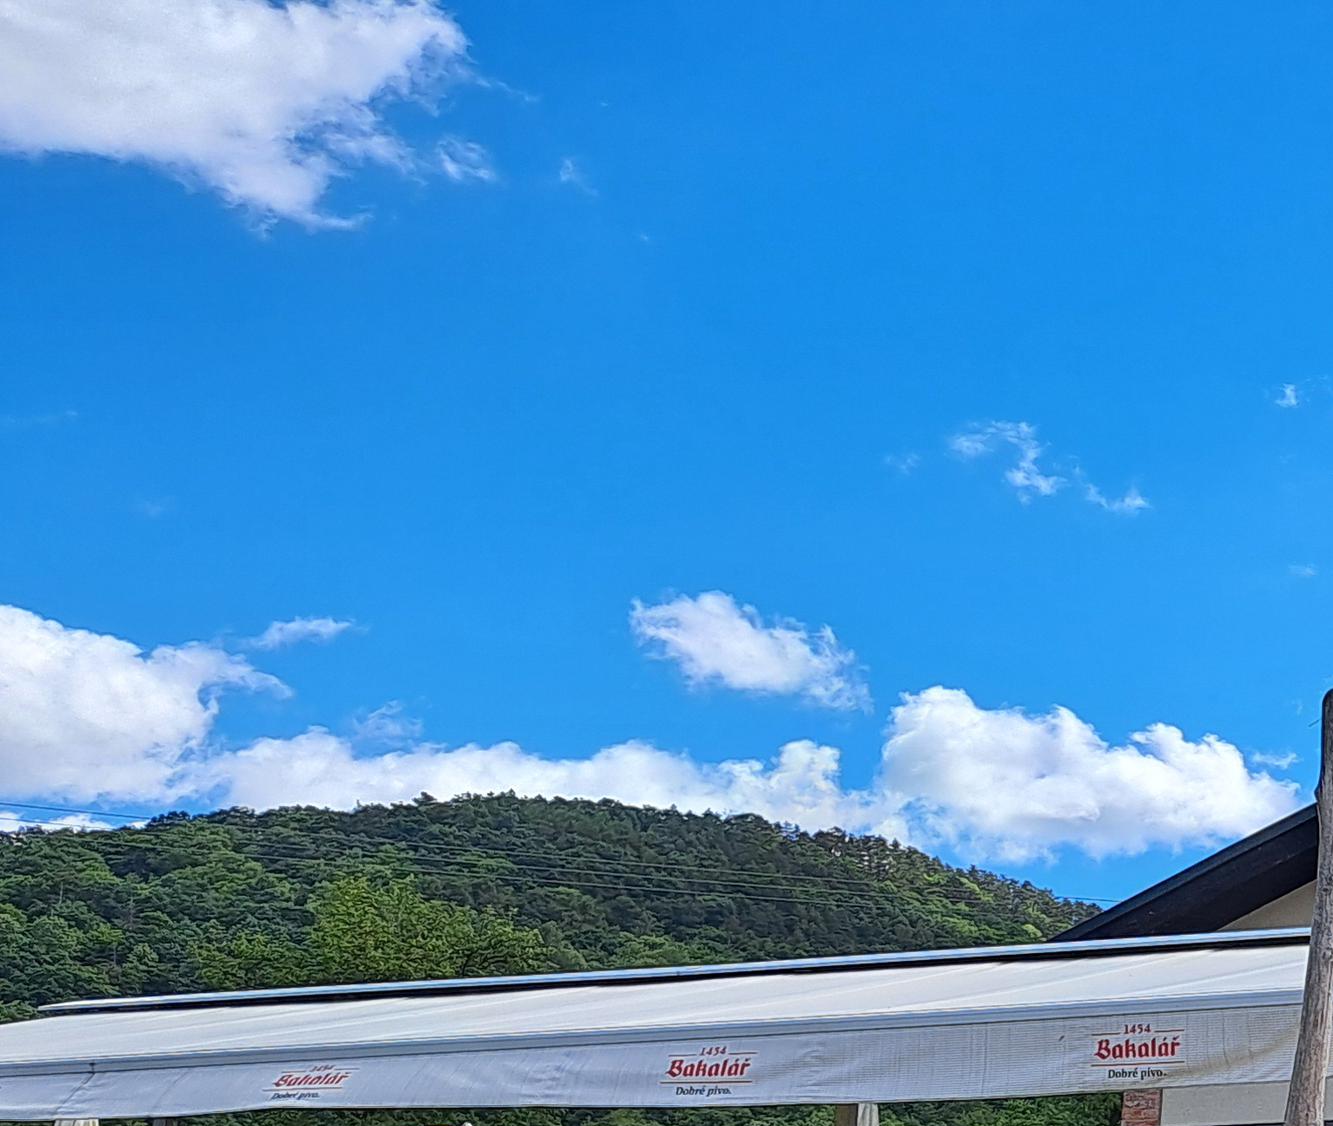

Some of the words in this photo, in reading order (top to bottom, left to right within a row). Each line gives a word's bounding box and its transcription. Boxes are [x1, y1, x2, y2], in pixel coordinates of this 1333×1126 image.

[1124, 1023, 1151, 1034] 1454
[700, 1046, 727, 1056] 1454
[1093, 1036, 1181, 1060] Bakalář
[665, 1058, 751, 1078] Bakalář
[1108, 1067, 1138, 1079] Dobré
[676, 1085, 705, 1096] Dobré
